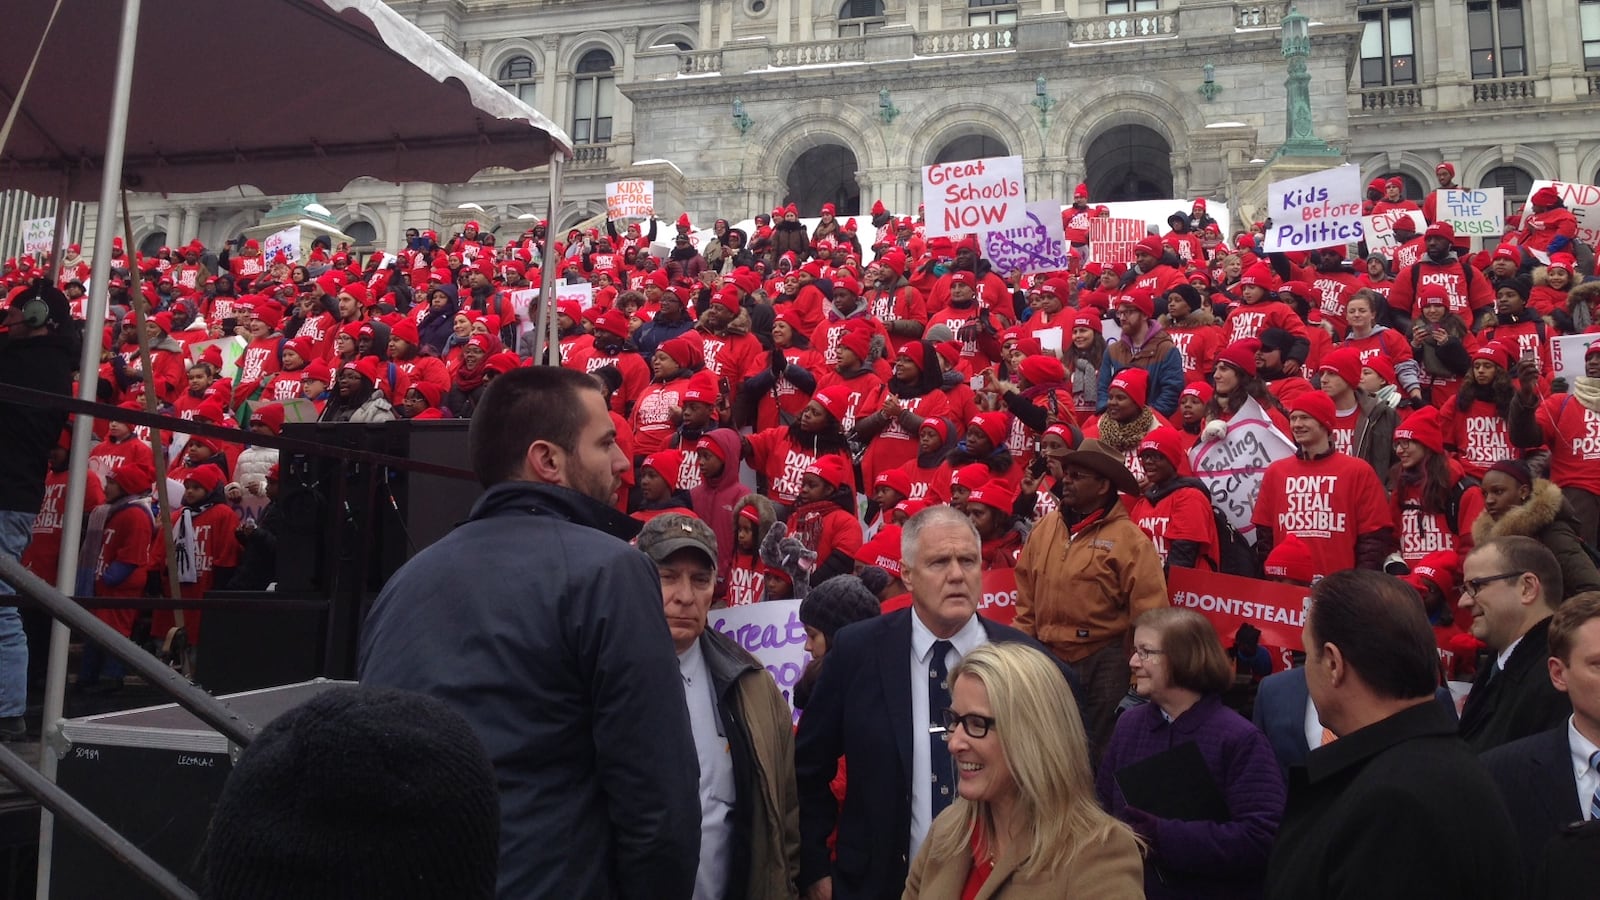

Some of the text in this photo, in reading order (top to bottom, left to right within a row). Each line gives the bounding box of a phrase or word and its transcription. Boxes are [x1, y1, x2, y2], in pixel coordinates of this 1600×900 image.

[928, 160, 985, 185] Great
[617, 181, 645, 194] KIDS
[944, 178, 1019, 204] Schools
[1447, 190, 1488, 204] END
[607, 194, 652, 207] BEFORE
[1283, 186, 1329, 211] Kids
[944, 202, 1007, 232] NOW
[1302, 199, 1361, 221] Before
[1448, 205, 1482, 217] THE
[28, 230, 54, 240] MOR
[1115, 218, 1147, 242] STEAL
[1276, 220, 1363, 248] Politics
[1422, 273, 1460, 286] DON'T
[1231, 312, 1266, 327] DON'T
[1466, 416, 1507, 432] DON'T
[1467, 431, 1508, 448] STEAL
[784, 450, 817, 471] DON
[1200, 430, 1259, 480] Failing
[782, 464, 805, 485] STE
[1209, 442, 1272, 505] School
[773, 478, 803, 496] POSS
[1285, 475, 1337, 494] DON'T
[1287, 493, 1333, 512] STEAL
[1278, 511, 1346, 533] POSSIBLE
